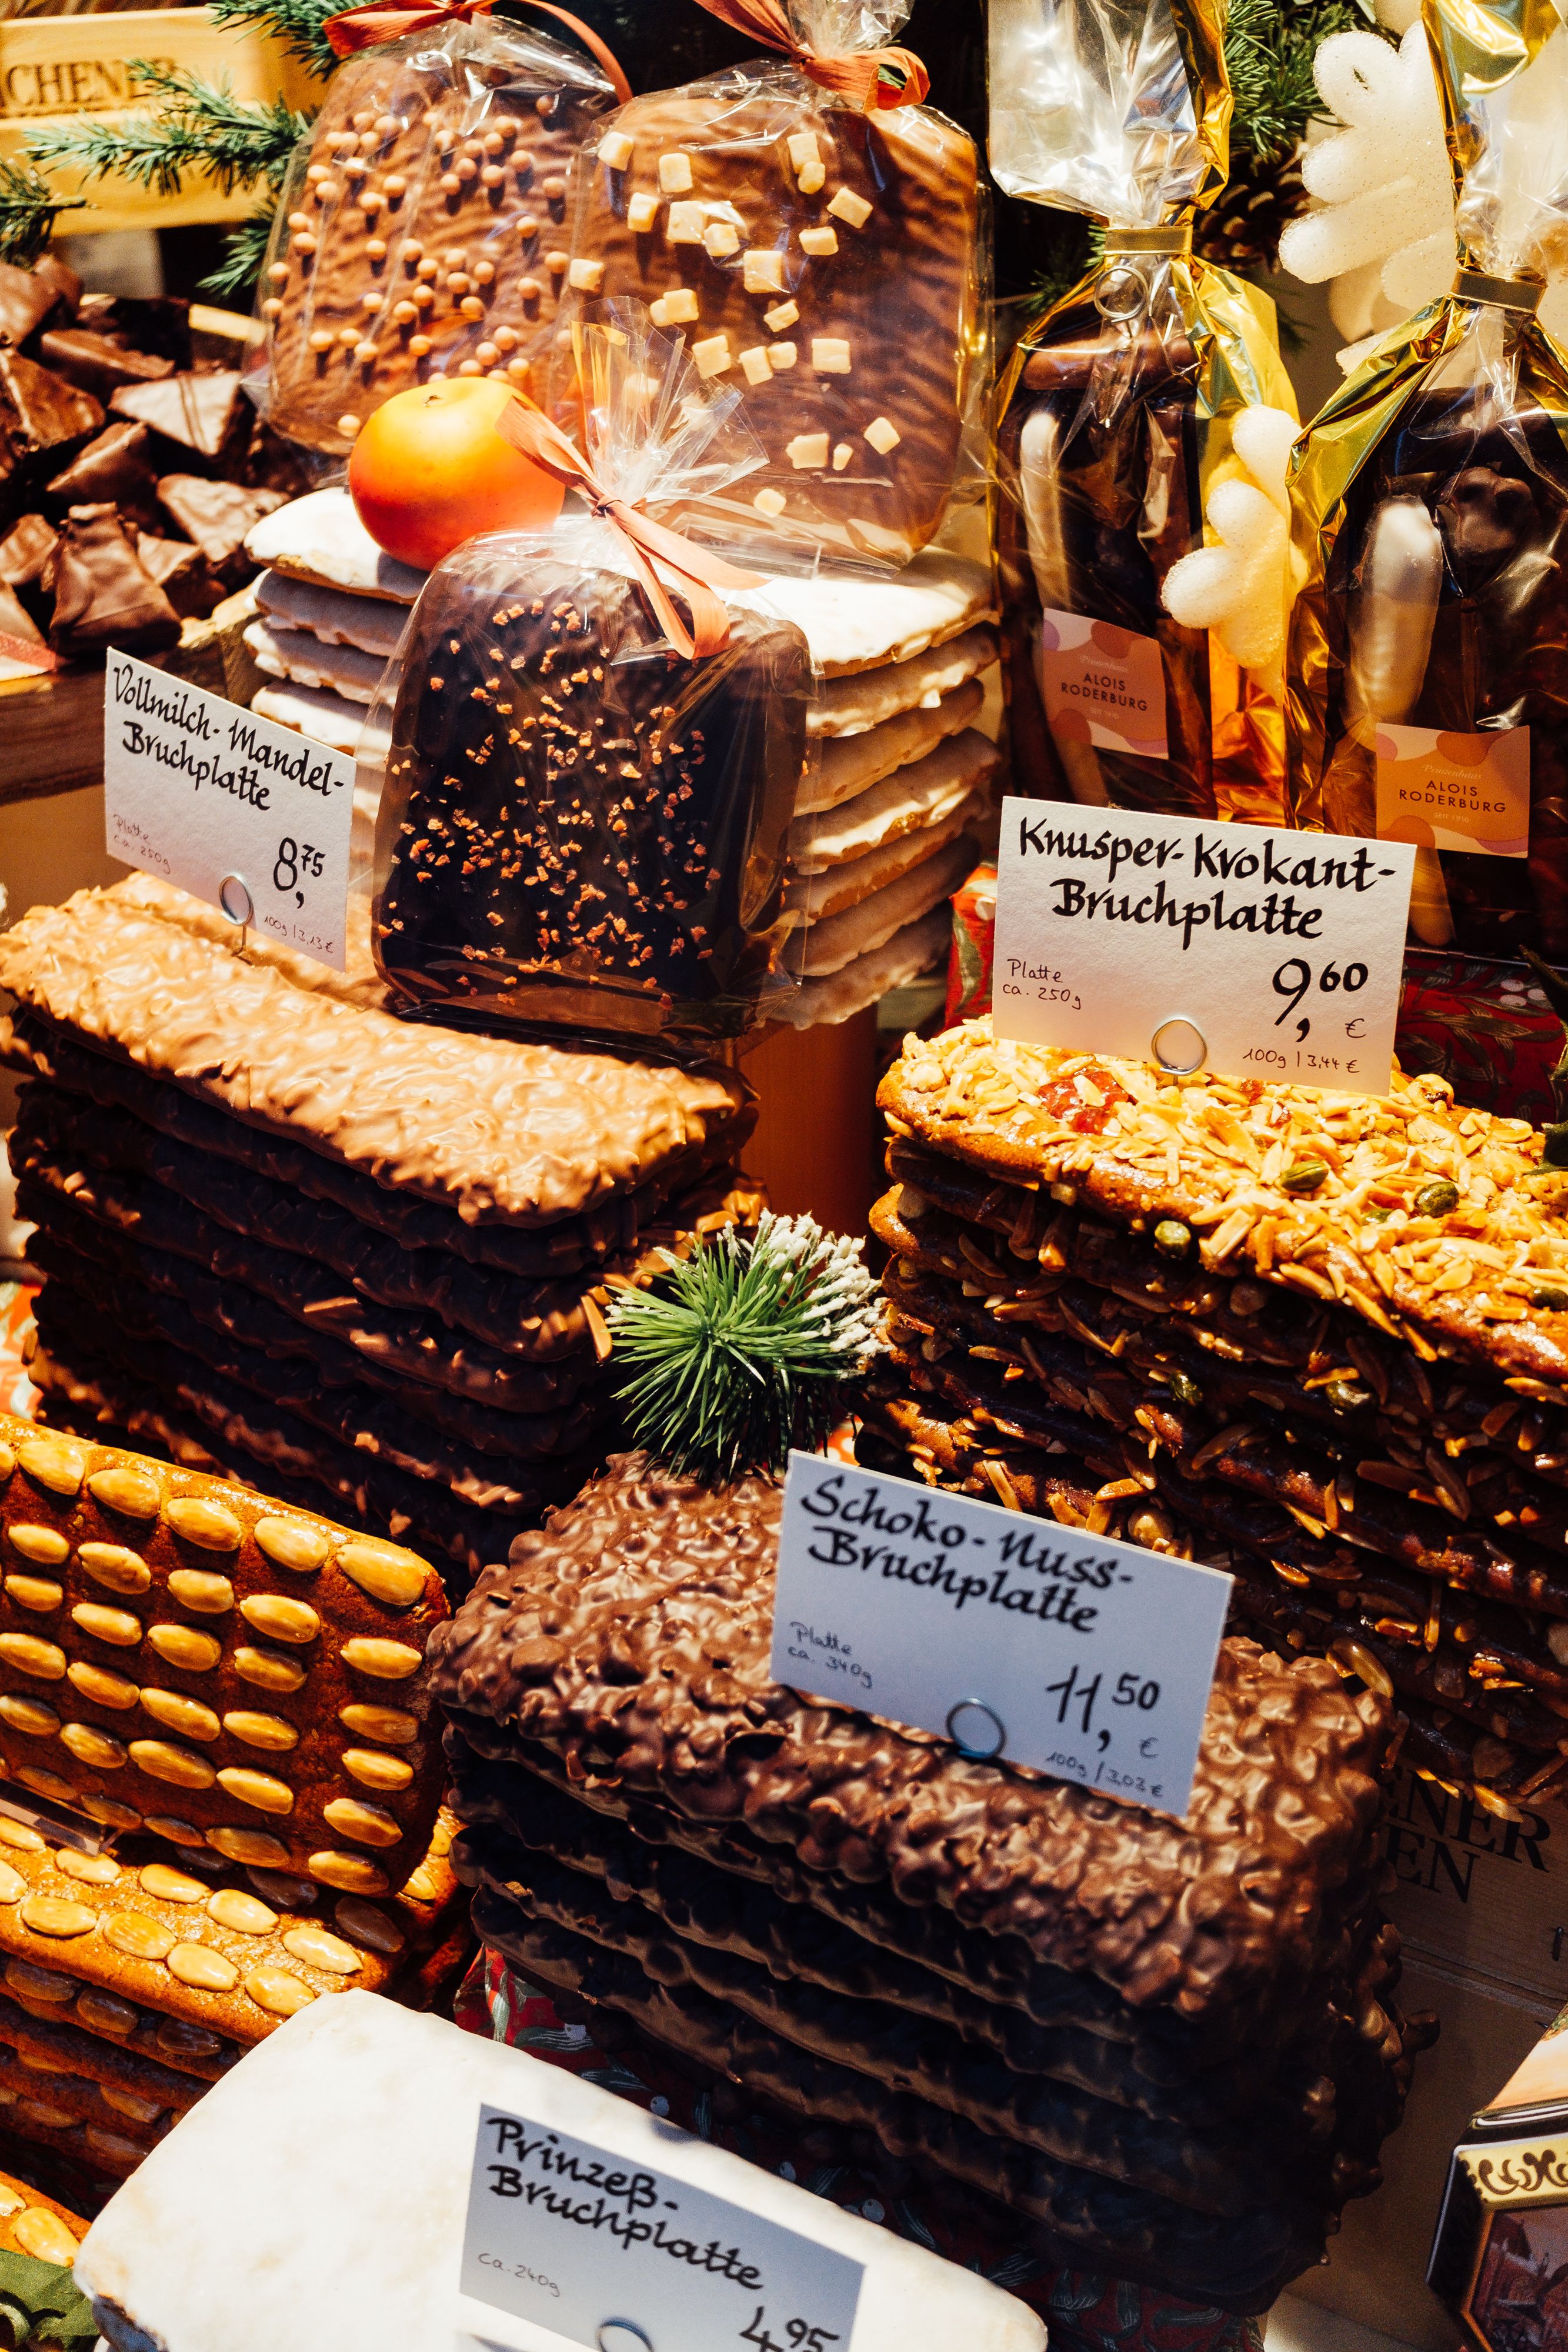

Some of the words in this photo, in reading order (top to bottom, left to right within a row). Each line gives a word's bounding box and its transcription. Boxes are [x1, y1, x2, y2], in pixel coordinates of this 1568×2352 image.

[1083, 673, 1126, 691] ALOIS
[1061, 682, 1147, 711] RODERBURG
[122, 720, 271, 810] Bruchplatte
[1399, 789, 1506, 812] RODERBURG
[1426, 780, 1477, 796] ALOIS
[1434, 812, 1449, 820] SEIT
[1050, 878, 1323, 950] Bruchplatte
[1007, 959, 1063, 983] Platte
[1003, 984, 1029, 995] ca.
[1038, 987, 1081, 1010] 250g
[1243, 1049, 1286, 1069] 100g
[808, 1526, 1099, 1633] Bruchplatte
[790, 1622, 852, 1655] Platte
[788, 1647, 815, 1664] ca.
[486, 2165, 763, 2290] Bruchplatte
